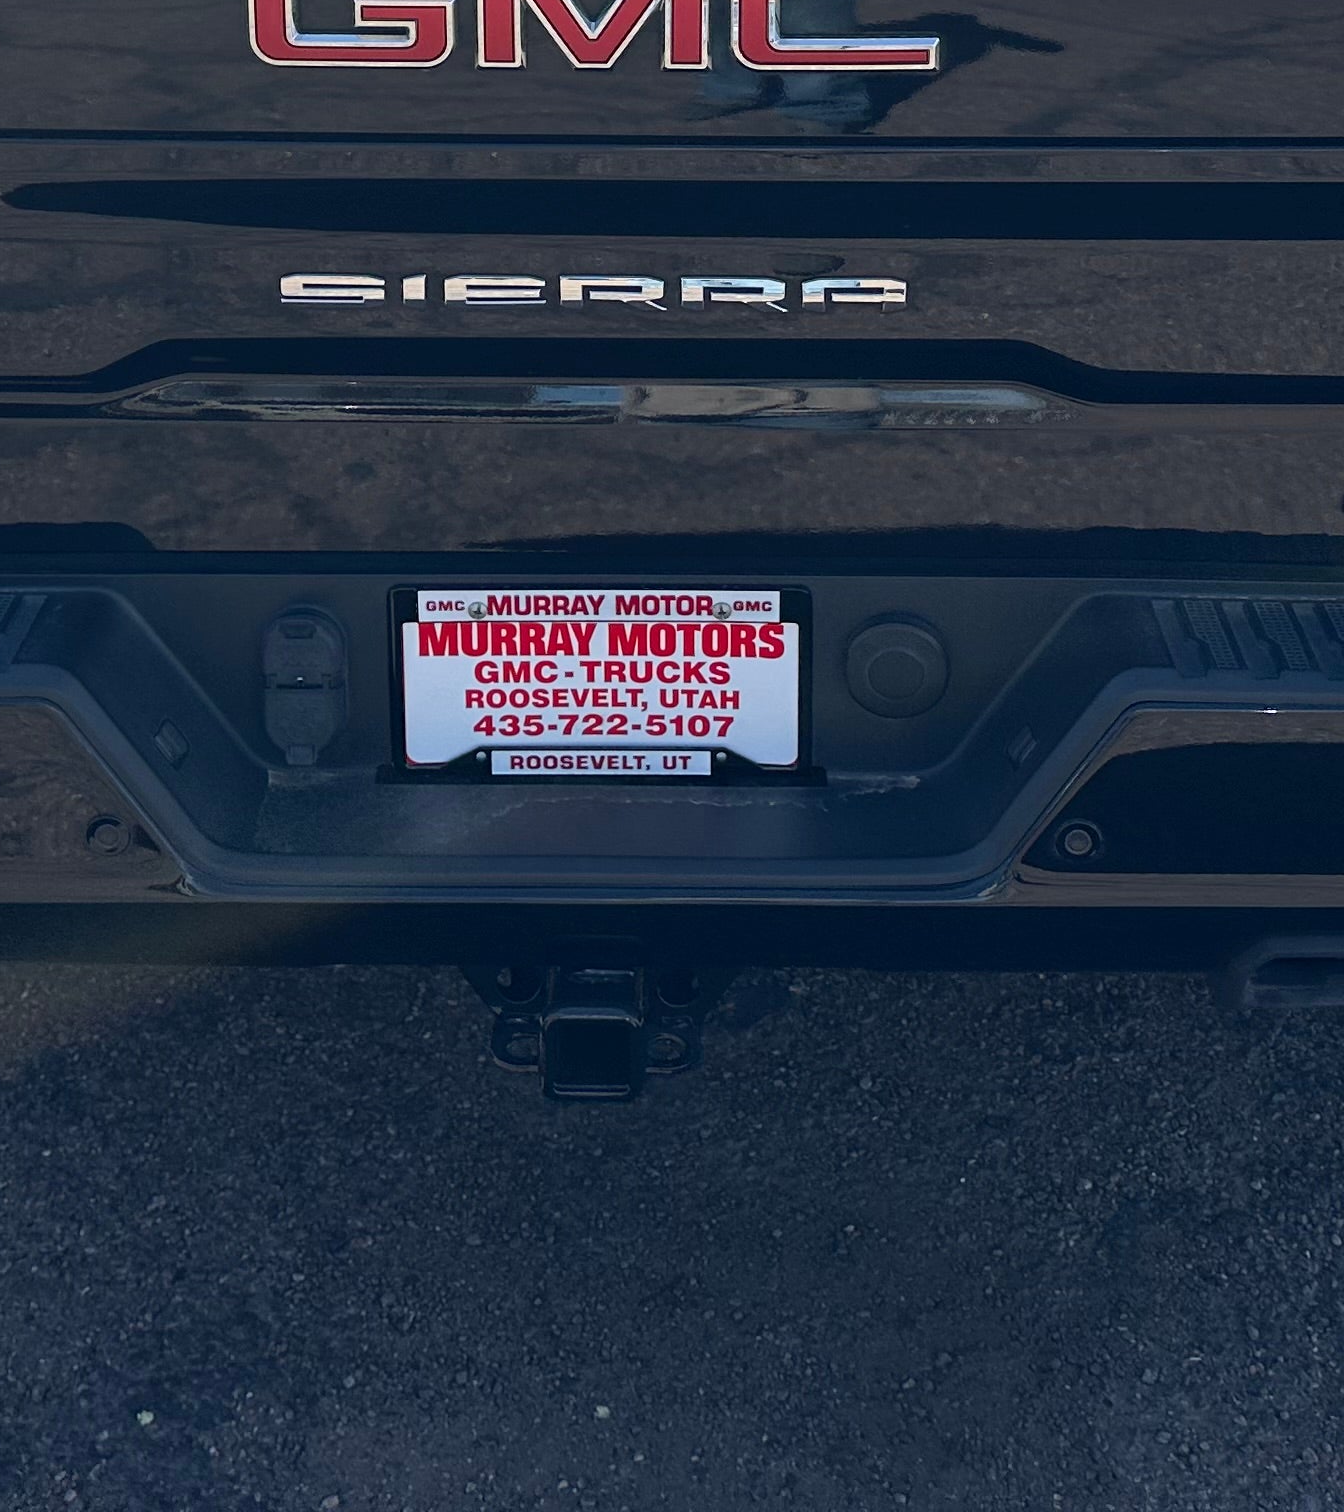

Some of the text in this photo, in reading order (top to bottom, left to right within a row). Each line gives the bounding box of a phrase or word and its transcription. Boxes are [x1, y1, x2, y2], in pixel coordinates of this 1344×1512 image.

[280, 273, 908, 313] SIERRA
[425, 594, 773, 617] GMC MURRAY MOTOR GMC
[417, 622, 785, 659] MURRAY MOTORS
[464, 688, 741, 712] ROOSEVELT, UTAH
[473, 714, 735, 738] 435-722-5107
[509, 754, 693, 772] ROOSEVELT, UT
